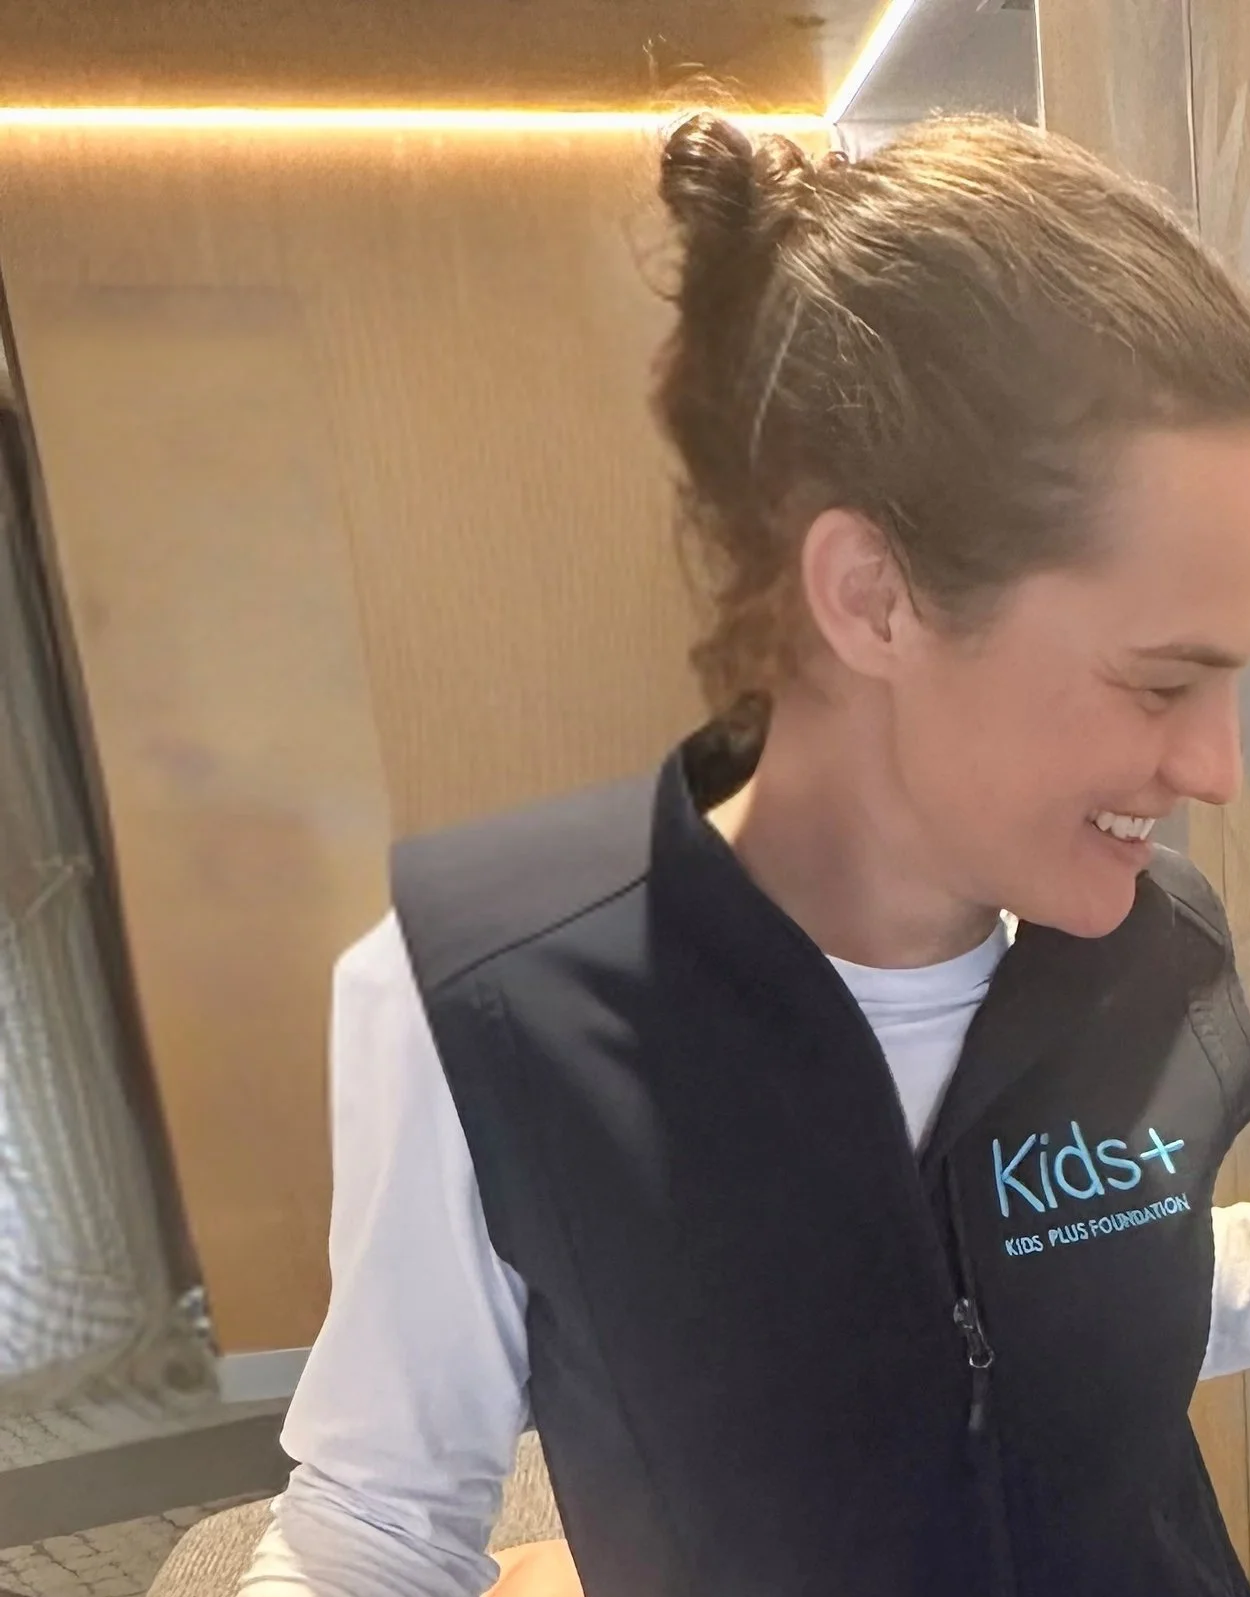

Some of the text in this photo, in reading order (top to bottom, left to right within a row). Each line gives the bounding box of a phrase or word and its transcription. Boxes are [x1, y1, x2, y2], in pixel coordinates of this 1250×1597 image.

[992, 1120, 1185, 1218] Kids+
[1005, 1192, 1191, 1257] KIDS PLUS FOUNDATION
